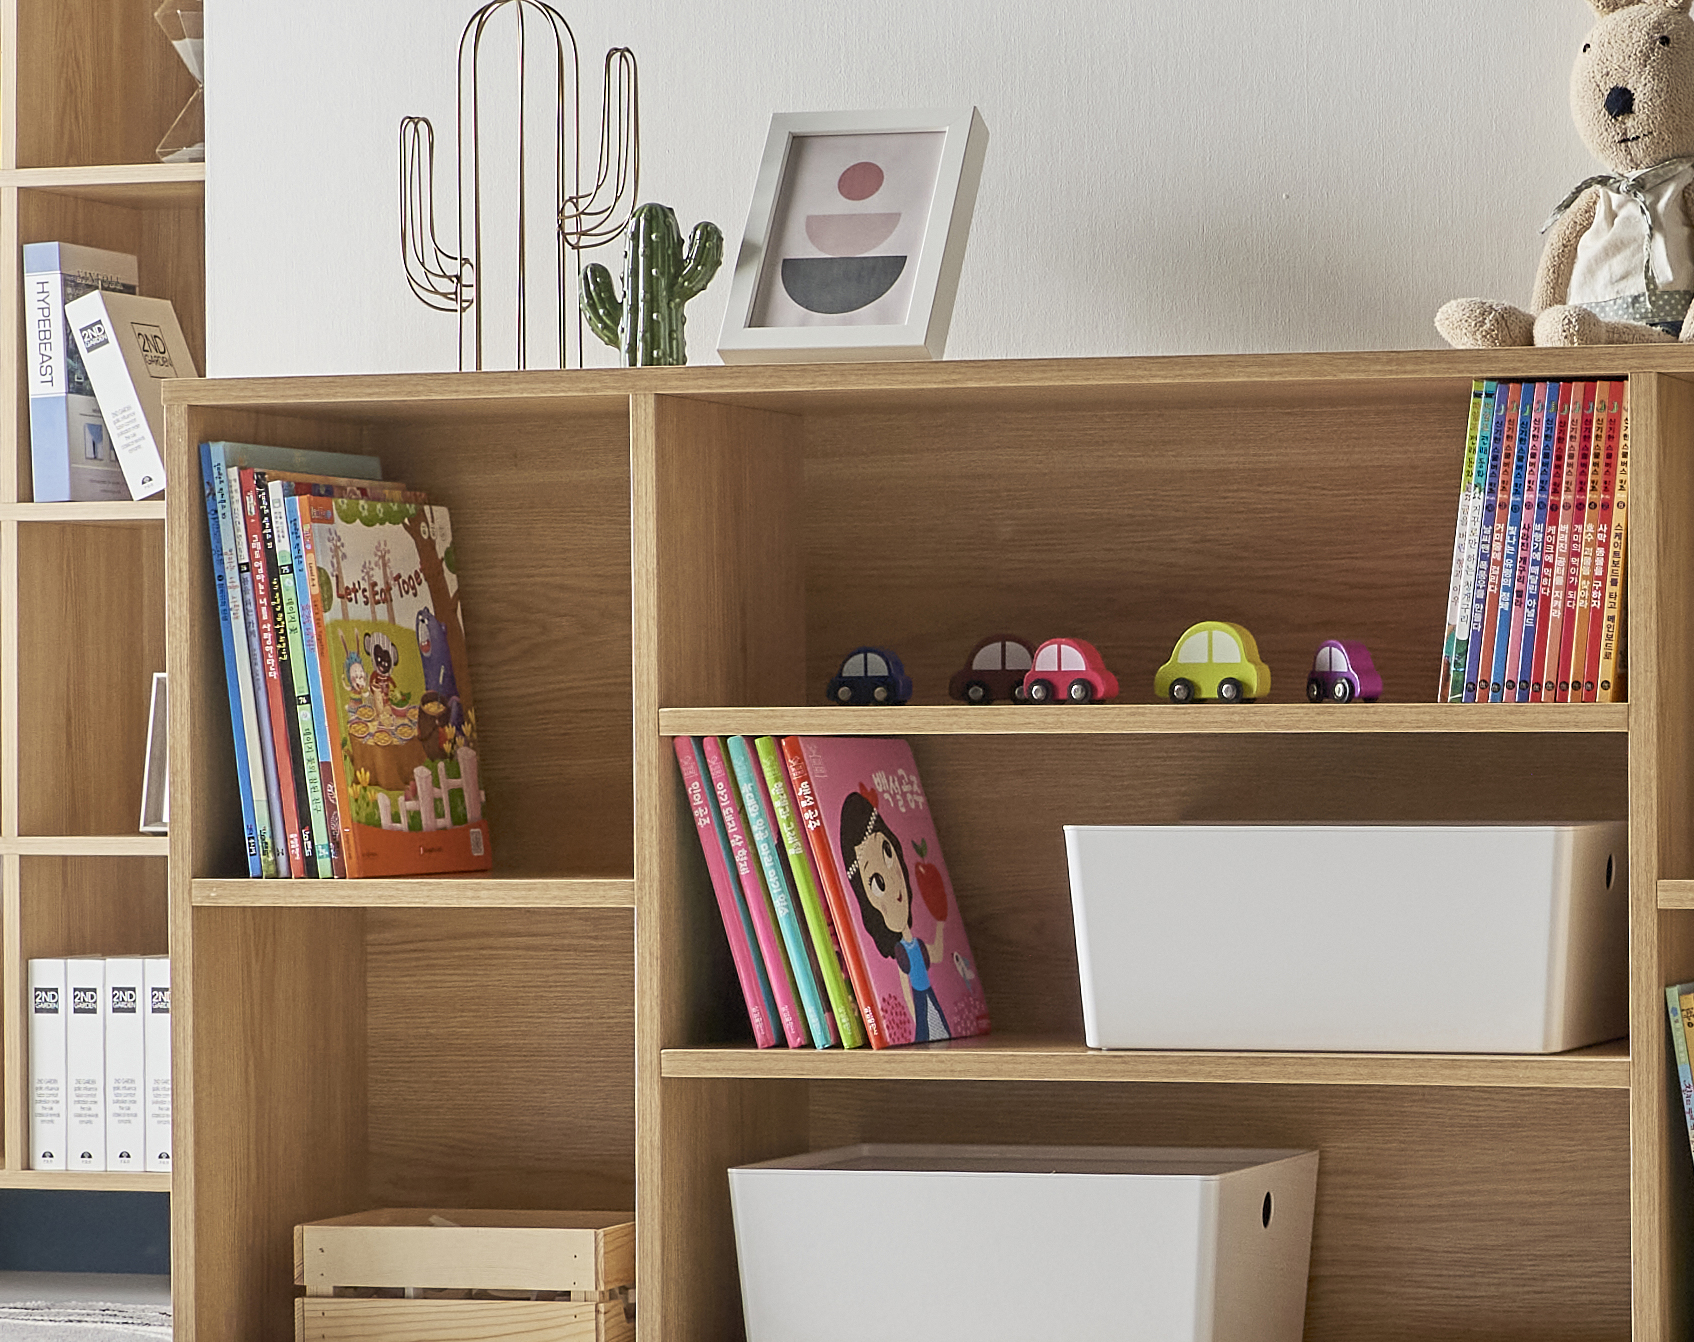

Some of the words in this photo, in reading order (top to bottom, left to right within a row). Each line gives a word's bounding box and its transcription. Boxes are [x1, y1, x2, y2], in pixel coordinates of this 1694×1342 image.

[36, 281, 54, 387] HYPEBEAST
[81, 324, 106, 342] 2ND
[137, 332, 166, 354] 2ND
[335, 573, 369, 606] Let's
[370, 580, 393, 606] Eat
[285, 597, 296, 623] 데이지
[302, 727, 313, 752] 데이지
[688, 781, 704, 804] 인어
[872, 771, 906, 813] 백설
[897, 768, 925, 810] 공주
[693, 806, 712, 827] 공주
[797, 780, 813, 806] 백설
[805, 808, 820, 830] 공주
[758, 843, 775, 866] 마리
[766, 868, 783, 892] 아기
[35, 991, 58, 1002] 2ND
[74, 991, 97, 1003] 2ND
[113, 991, 136, 1002] 2ND
